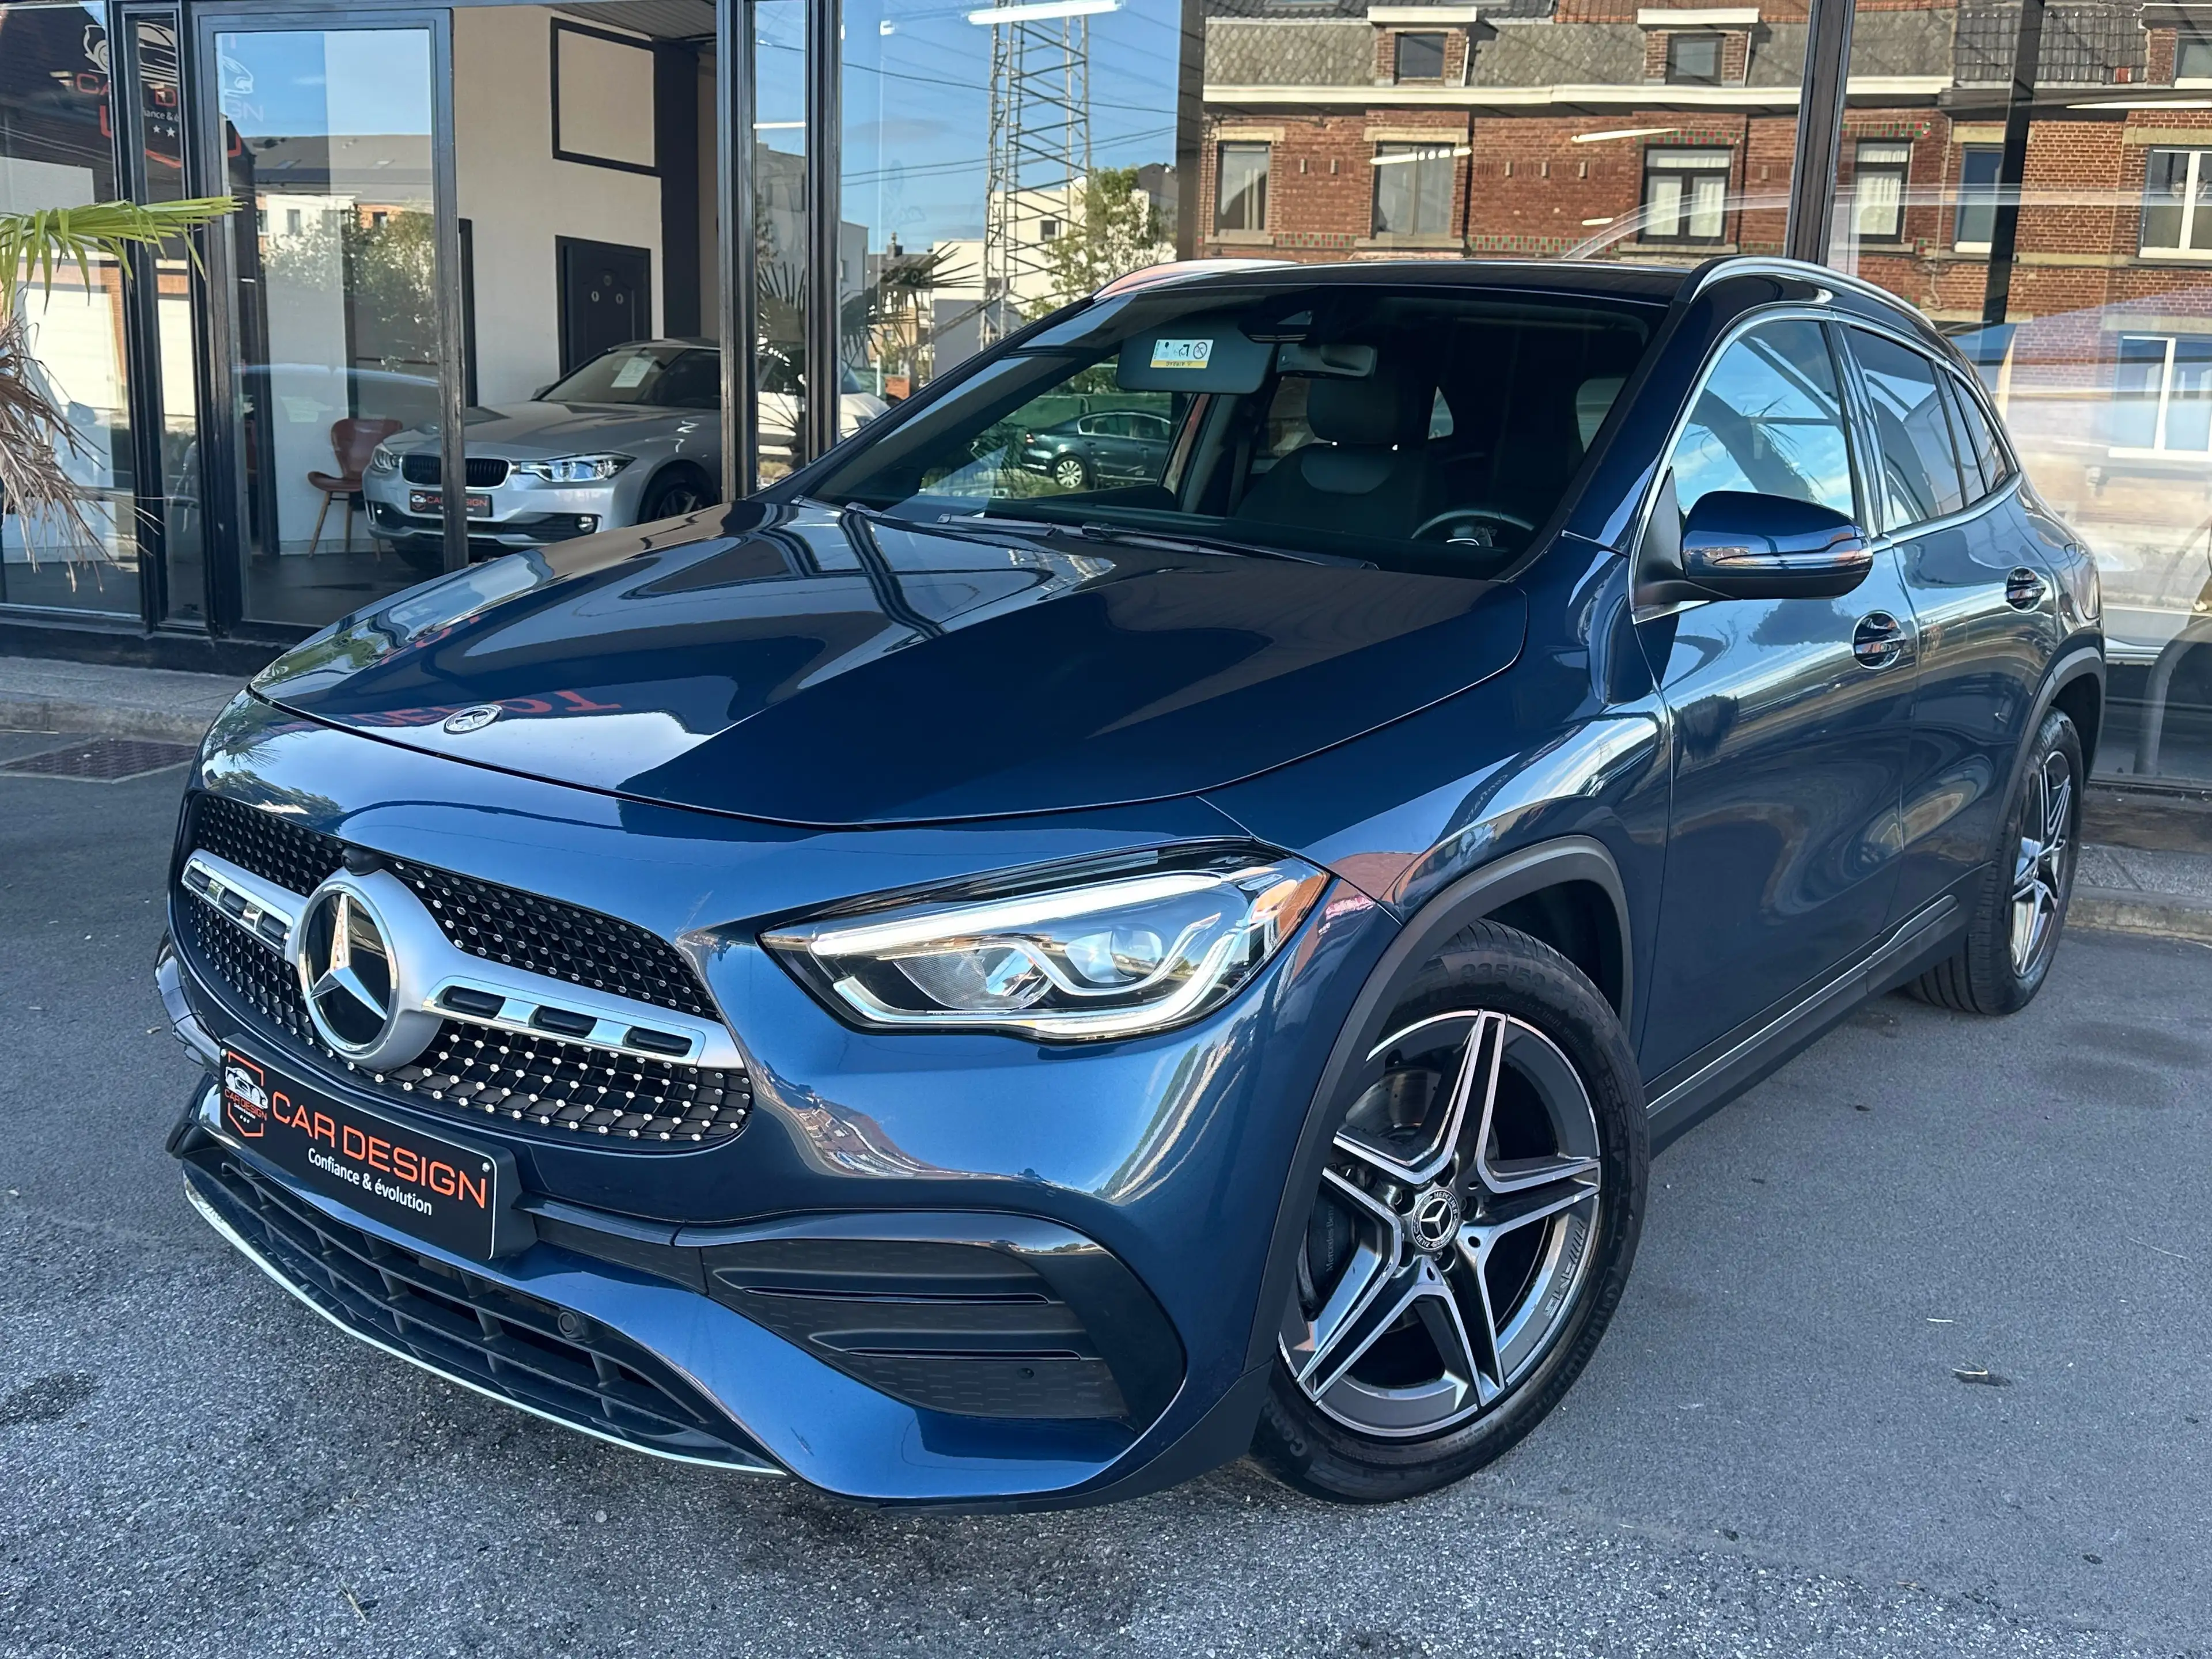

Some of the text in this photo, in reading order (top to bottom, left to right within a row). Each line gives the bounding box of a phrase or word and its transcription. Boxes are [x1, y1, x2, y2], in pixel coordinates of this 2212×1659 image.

[166, 112, 173, 121] &
[427, 496, 487, 507] CA SIGN
[225, 1088, 240, 1104] CAR
[240, 1098, 267, 1121] DESIGN
[272, 1091, 486, 1209] CAR DESIGN
[308, 1147, 433, 1215] Confiance & évolution
